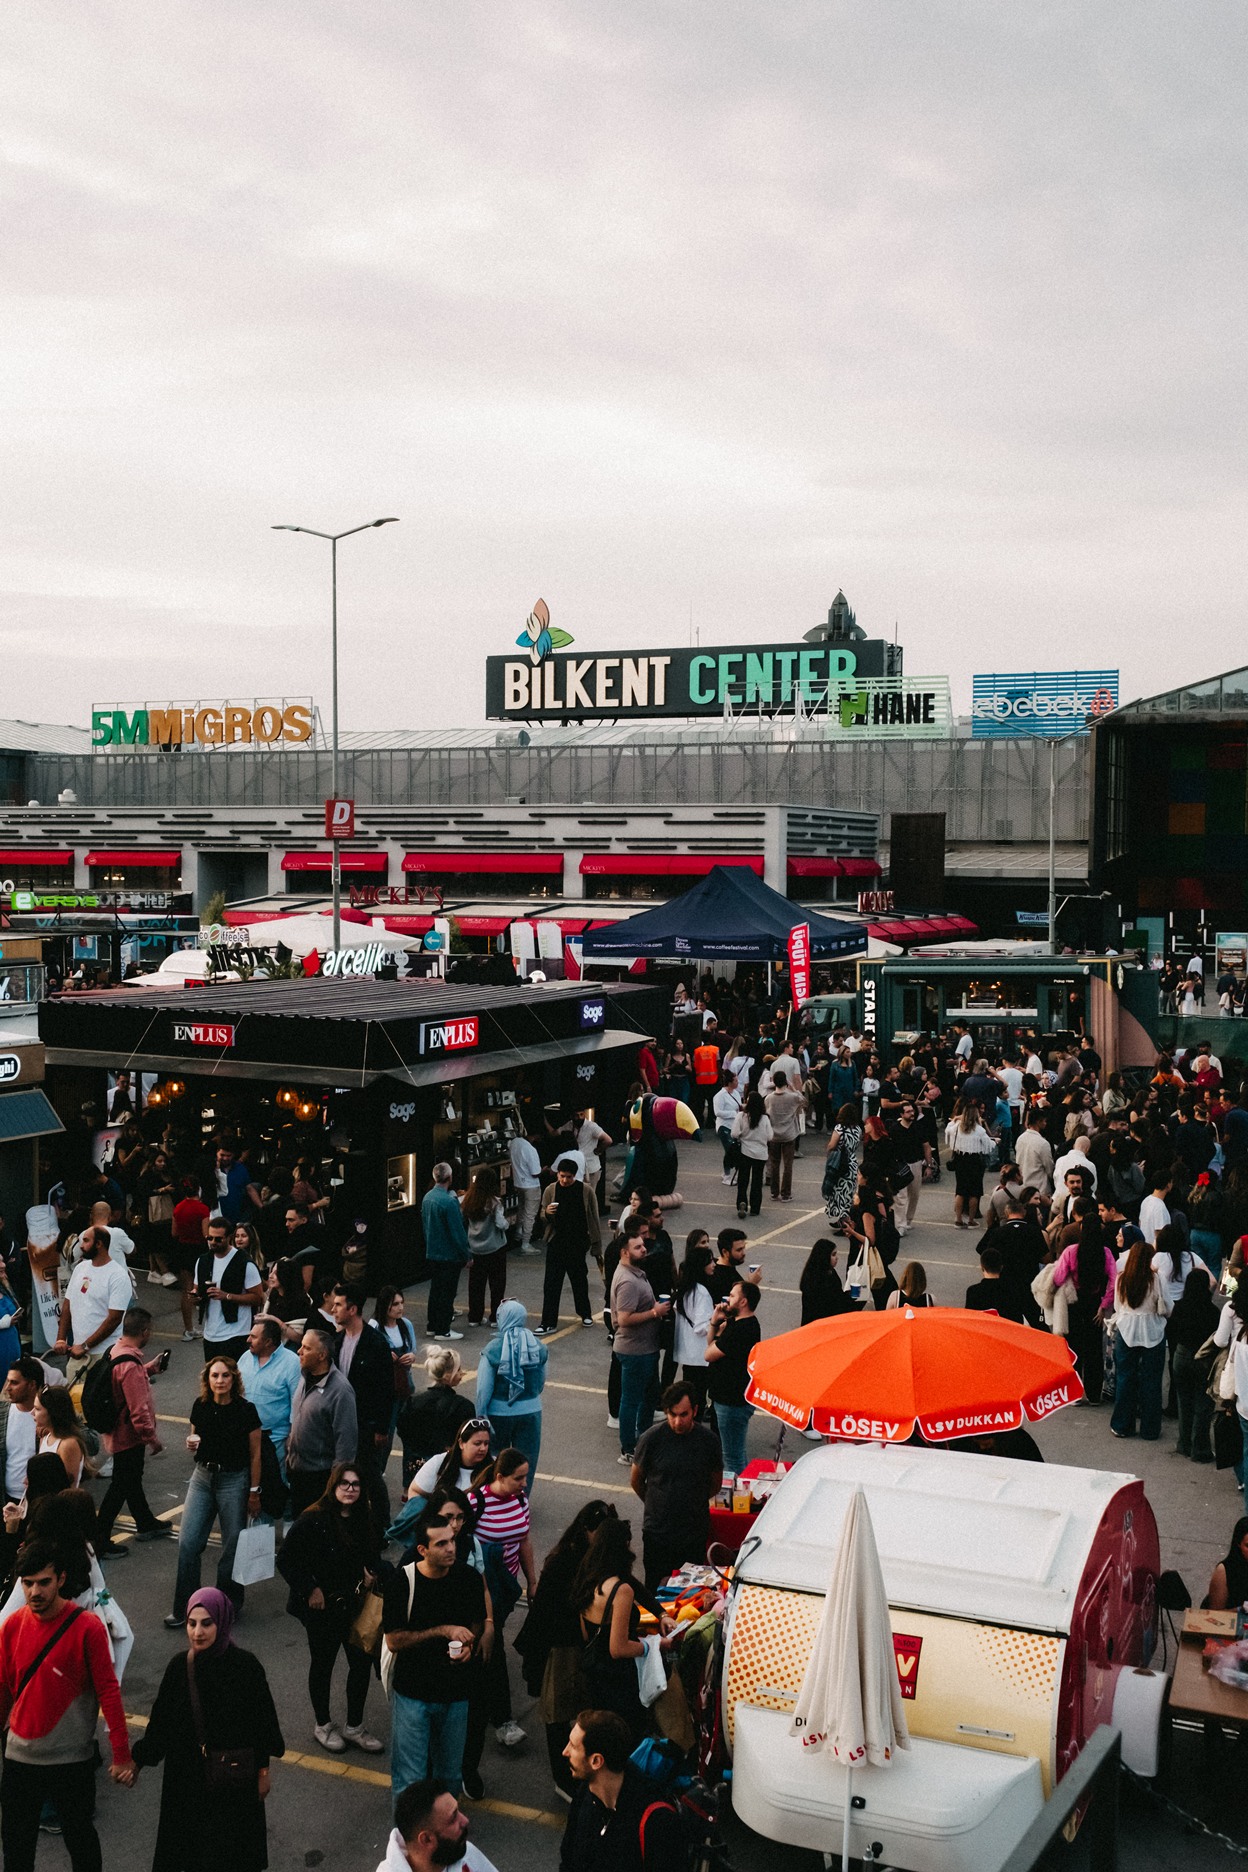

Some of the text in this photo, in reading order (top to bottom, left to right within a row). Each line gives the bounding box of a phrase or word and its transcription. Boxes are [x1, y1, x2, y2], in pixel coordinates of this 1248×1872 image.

[689, 649, 857, 705] CENTER
[873, 692, 935, 725] HANE
[973, 691, 1088, 718] ebebek
[332, 802, 351, 824] D
[350, 885, 444, 906] MICKEY'S
[583, 1005, 603, 1023] Sage
[174, 1025, 227, 1043] ENPLUS
[429, 1022, 475, 1049] ENPLUS
[576, 1064, 595, 1081] Sage
[389, 1102, 416, 1122] Sage
[829, 1414, 900, 1439] LÖSEV
